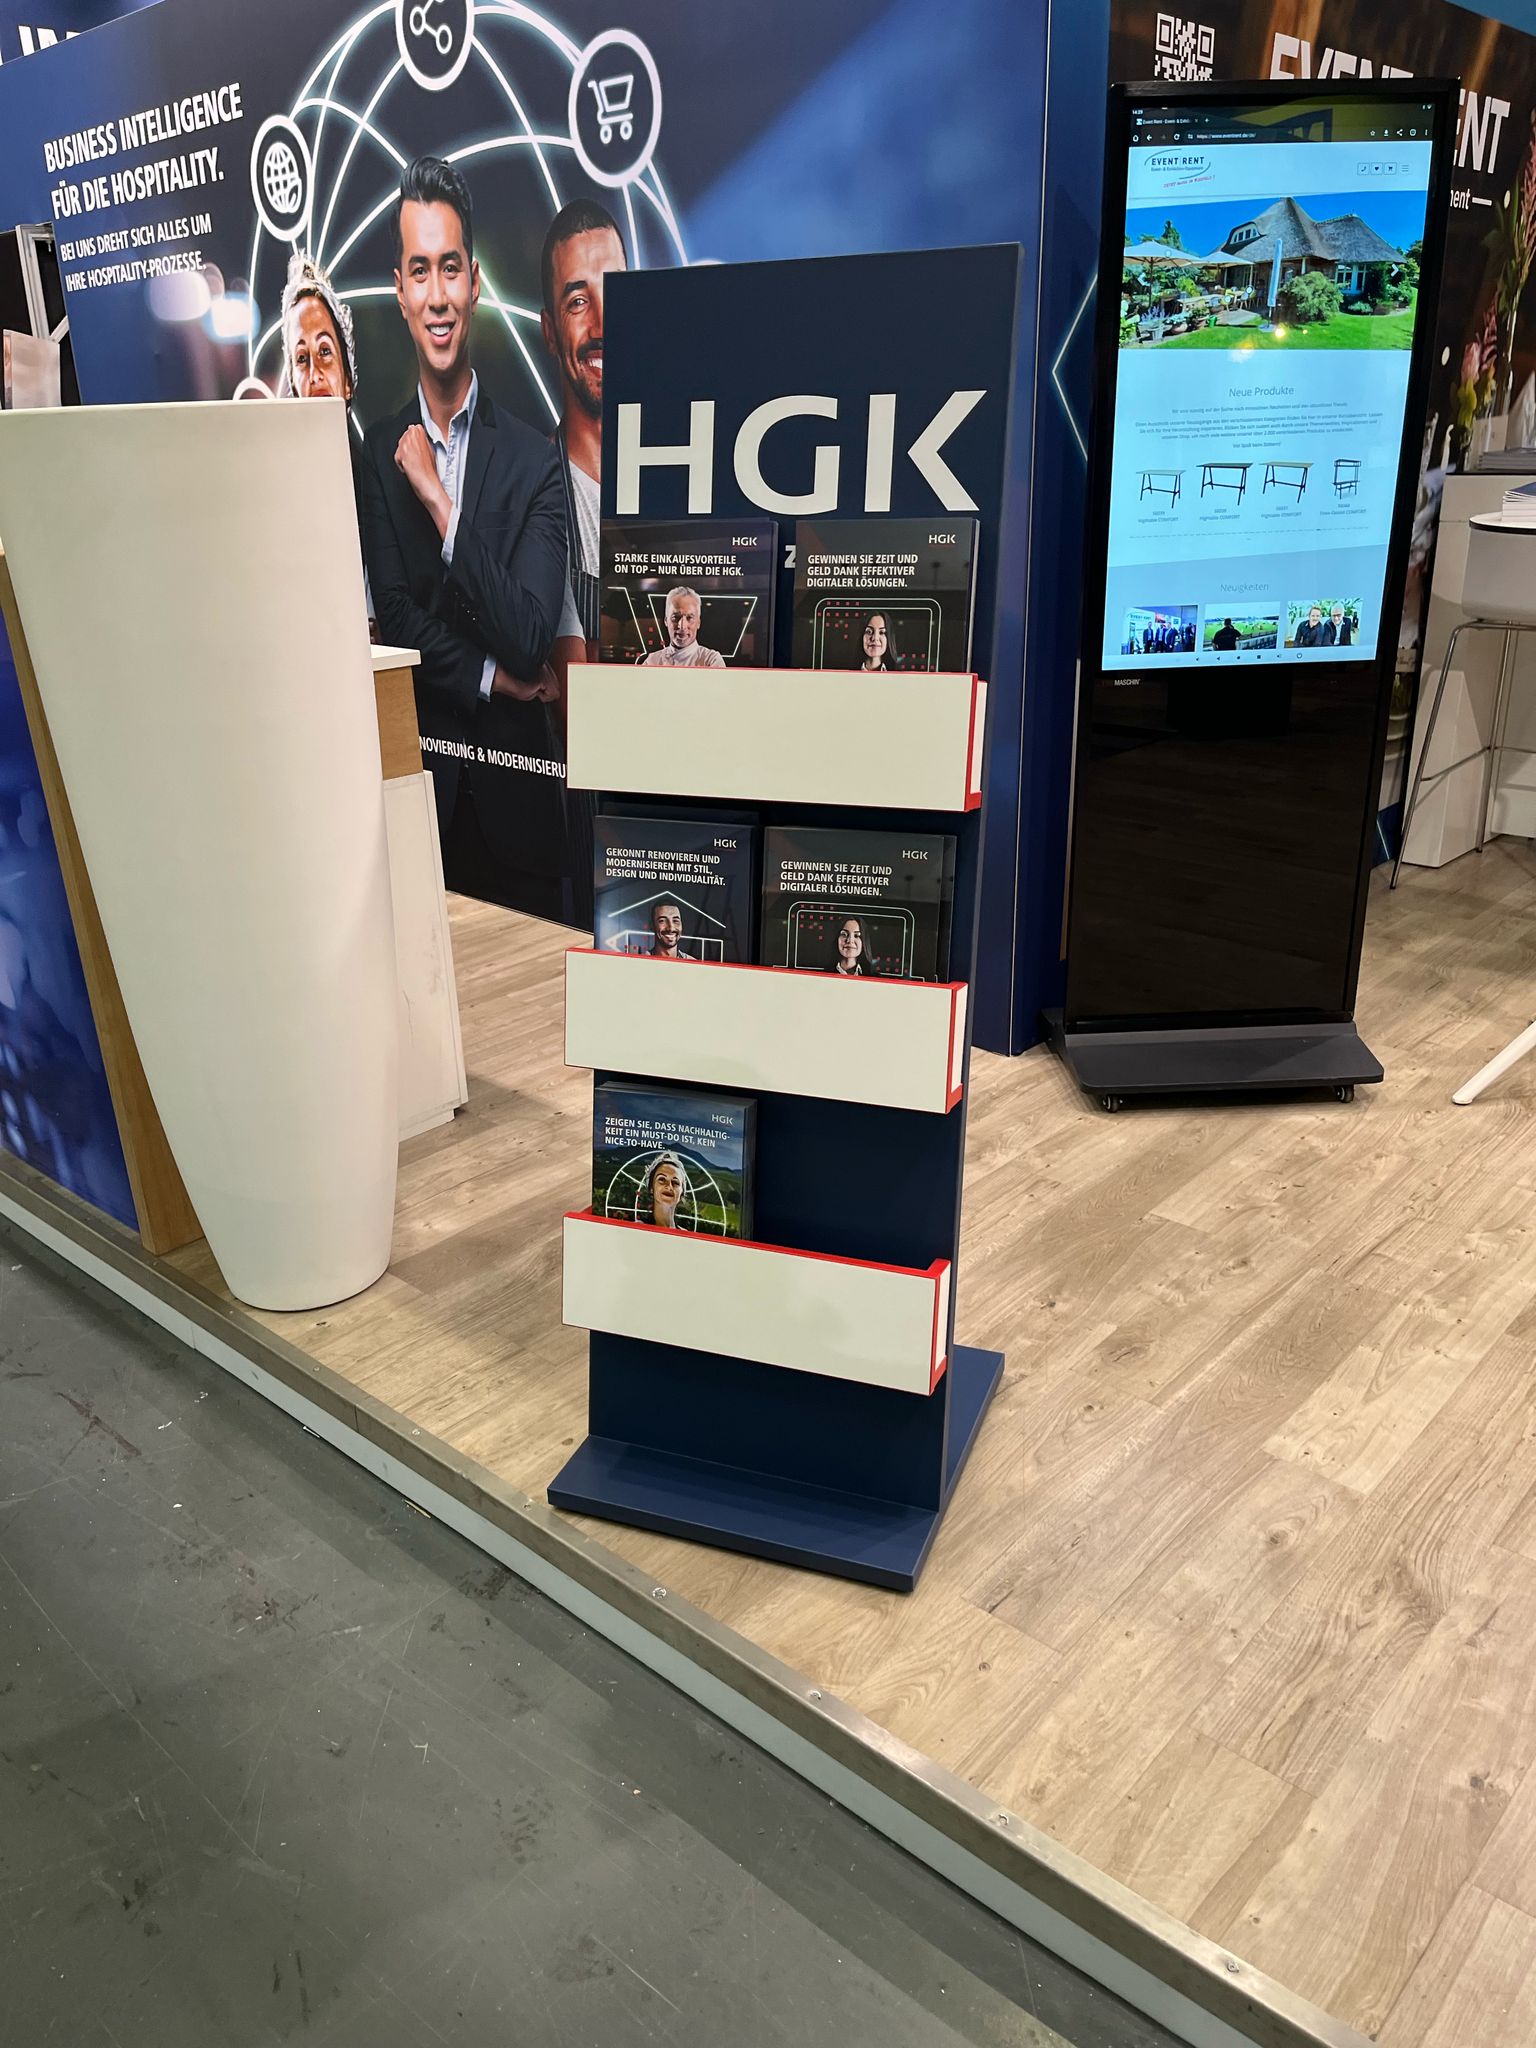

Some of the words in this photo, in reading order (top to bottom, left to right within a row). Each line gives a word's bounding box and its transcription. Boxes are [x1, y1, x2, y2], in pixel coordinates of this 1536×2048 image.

[43, 122, 117, 173] BUSINESS
[118, 82, 243, 151] INTELLIGENCE
[1151, 157, 1178, 166] EVENT
[1182, 156, 1205, 165] RENT
[51, 180, 82, 220] FÜR
[82, 176, 111, 212] DIE
[110, 146, 225, 205] HOSPITALITY.
[60, 241, 75, 262] BEI
[77, 237, 96, 258] UNS
[97, 230, 129, 254] DREHT
[131, 225, 155, 248] SICH
[157, 217, 189, 239] ALLES
[190, 212, 212, 236] UM
[65, 271, 87, 292] IHRE
[87, 250, 207, 288] HOSPITALITY-PROZESSE.
[1229, 388, 1252, 397] Neue
[1254, 386, 1294, 396] Produkte
[616, 390, 987, 515] HGK
[732, 537, 757, 546] HGK
[928, 534, 955, 544] HGK
[614, 553, 648, 563] STARKE
[650, 554, 736, 565] EINKAUFSVORTEILE
[808, 554, 857, 564] GEWINNEN
[859, 554, 874, 564] SIE
[875, 554, 895, 564] ZEIT
[897, 554, 918, 564] UND
[614, 565, 628, 574] ON
[630, 565, 648, 574] TOP
[658, 566, 677, 575] NUR
[680, 564, 702, 575] ÜBER
[705, 566, 720, 576] DIE
[722, 567, 744, 576] HGK.
[807, 566, 831, 576] GELD
[833, 566, 859, 576] DANK
[861, 566, 915, 576] EFFEKTIVER
[807, 577, 853, 587] DIGITALER
[855, 575, 907, 587] LÖSUNGEN.
[1220, 582, 1269, 593] Neuigkeiten
[477, 747, 486, 762] &
[714, 838, 736, 848] HGK
[606, 848, 645, 858] GEKONNT
[648, 850, 700, 863] RENOVIEREN
[702, 854, 720, 864] UND
[902, 850, 928, 860] HGK
[606, 857, 674, 871] MODERNISIEREN
[676, 863, 691, 872] MIT
[693, 865, 712, 875] STIL,
[781, 860, 832, 872] GEWINNEN
[834, 863, 848, 872] SIE
[850, 864, 870, 874] ZEIT
[871, 865, 892, 876] UND
[606, 868, 636, 878] DESIGN
[639, 870, 657, 880] UND
[659, 871, 726, 886] INDIVIDUALITÄT.
[780, 871, 805, 881] GELD
[807, 872, 833, 883] DANK
[836, 874, 889, 886] EFFEKTIVER
[780, 882, 828, 893] DIGITALER
[830, 883, 882, 896] LÖSUNGEN.
[711, 1114, 733, 1125] HGK
[605, 1117, 635, 1128] ZEIGEN
[637, 1120, 652, 1130] SIE,
[654, 1121, 676, 1132] DASS
[678, 1124, 730, 1140] NACHHALTIG-
[605, 1127, 623, 1137] KEIT
[625, 1128, 639, 1138] EIN
[641, 1130, 679, 1142] MUST-DO
[681, 1135, 695, 1145] IST,
[697, 1137, 716, 1148] KEIN
[605, 1136, 665, 1150] NICE-TO-HAVE.
